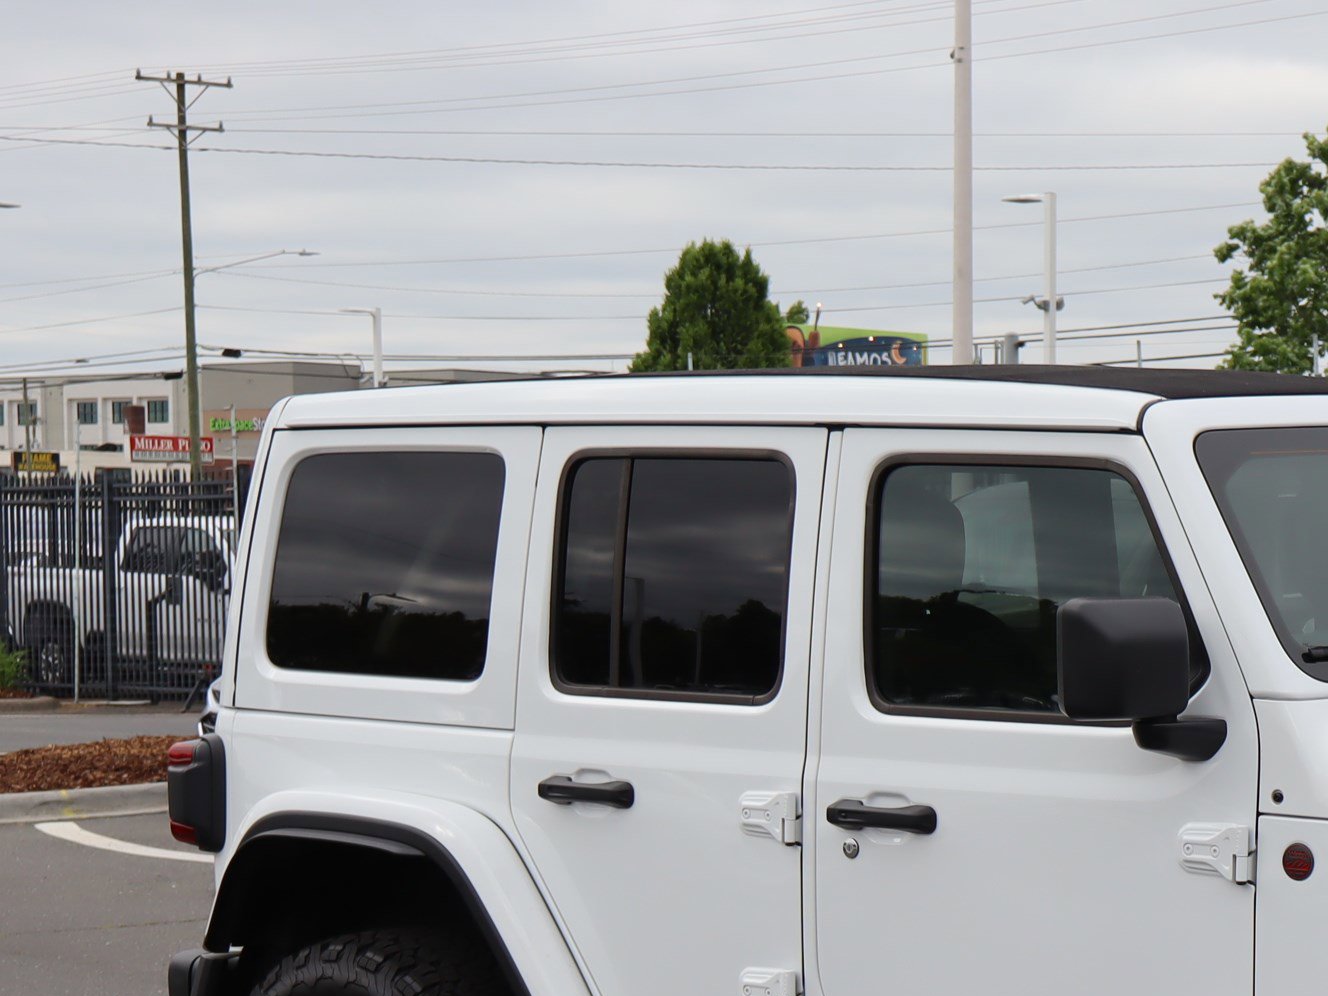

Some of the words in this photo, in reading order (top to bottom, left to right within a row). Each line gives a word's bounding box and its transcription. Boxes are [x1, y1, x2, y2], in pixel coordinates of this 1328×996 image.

[134, 437, 174, 450] MILLER
[178, 439, 211, 452] PIO
[22, 451, 52, 461] FAME
